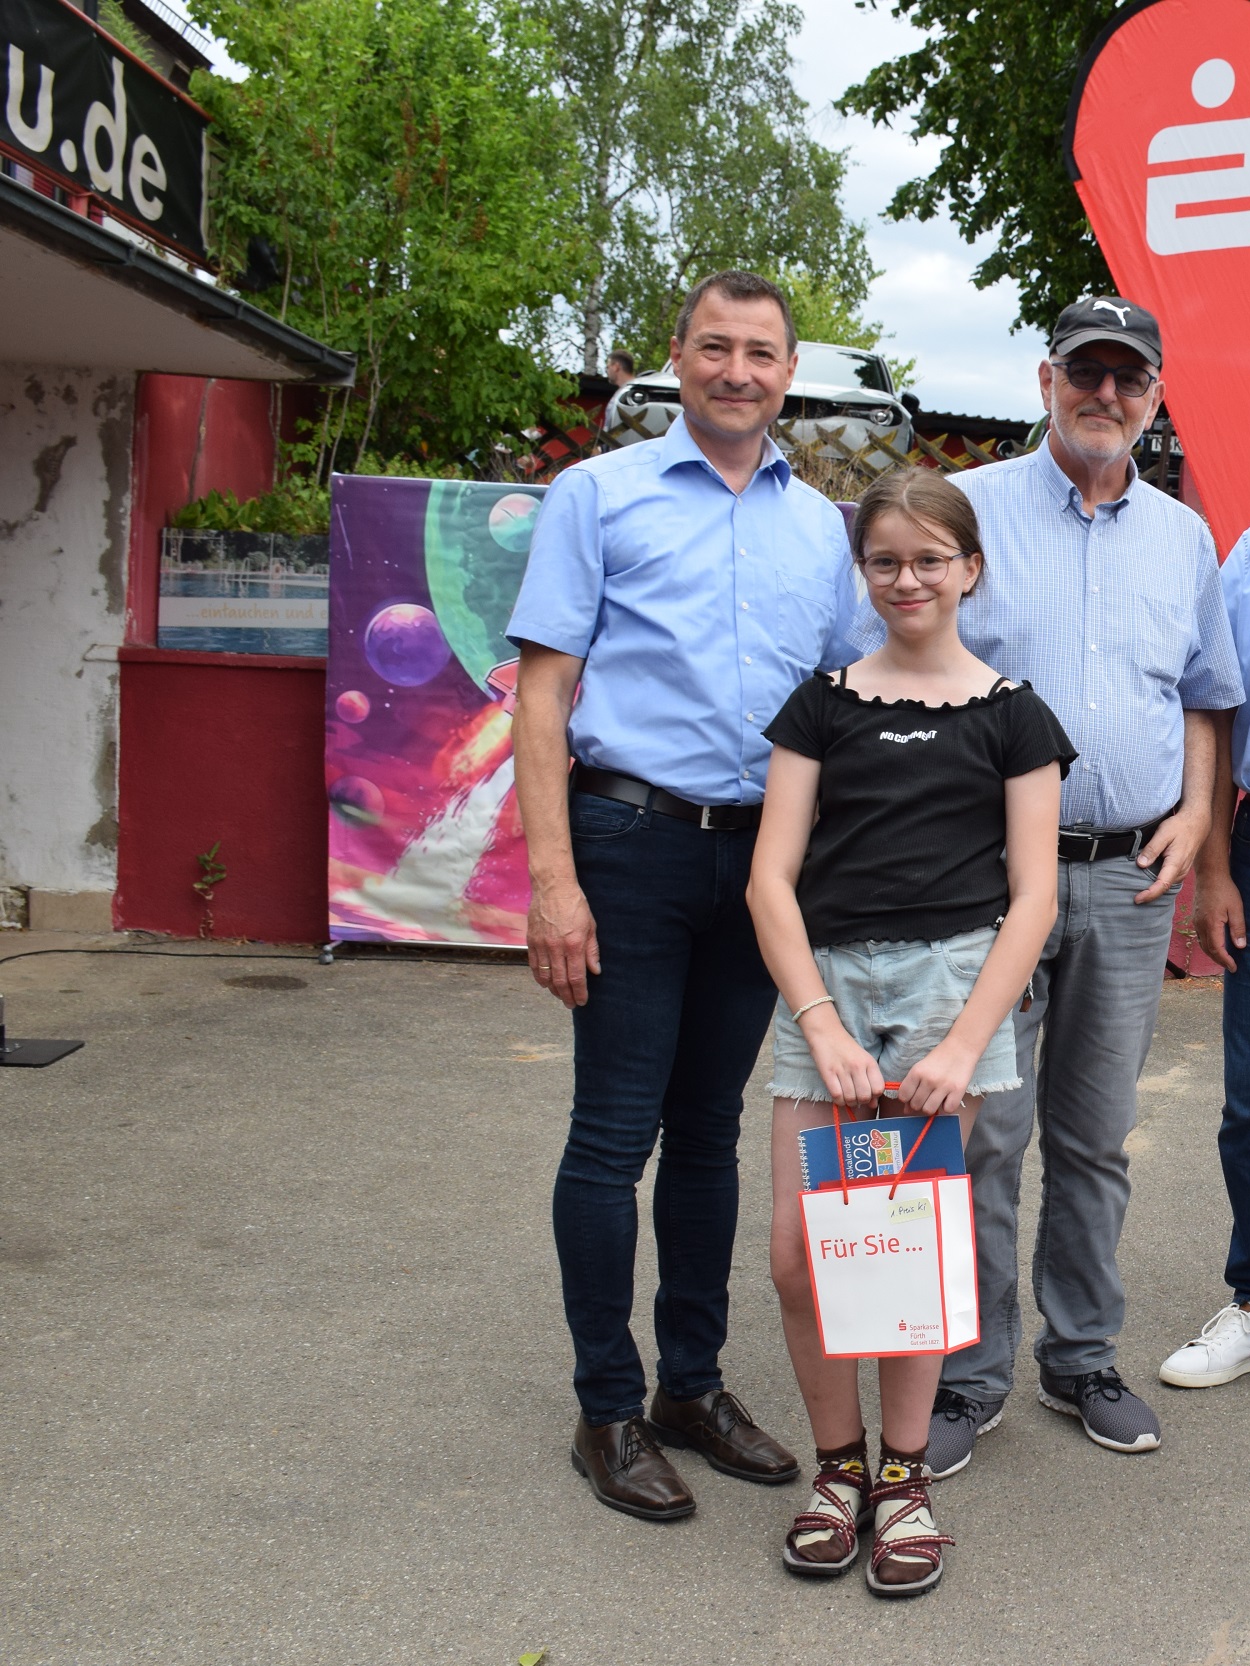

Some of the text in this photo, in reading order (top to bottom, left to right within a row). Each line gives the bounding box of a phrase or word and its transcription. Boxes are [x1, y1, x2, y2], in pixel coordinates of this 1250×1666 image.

[285, 603, 314, 618] und
[820, 1239, 858, 1260] Für
[863, 1233, 900, 1256] Sie
[909, 1324, 940, 1332] Sparkasse
[910, 1332, 926, 1340] Fürth
